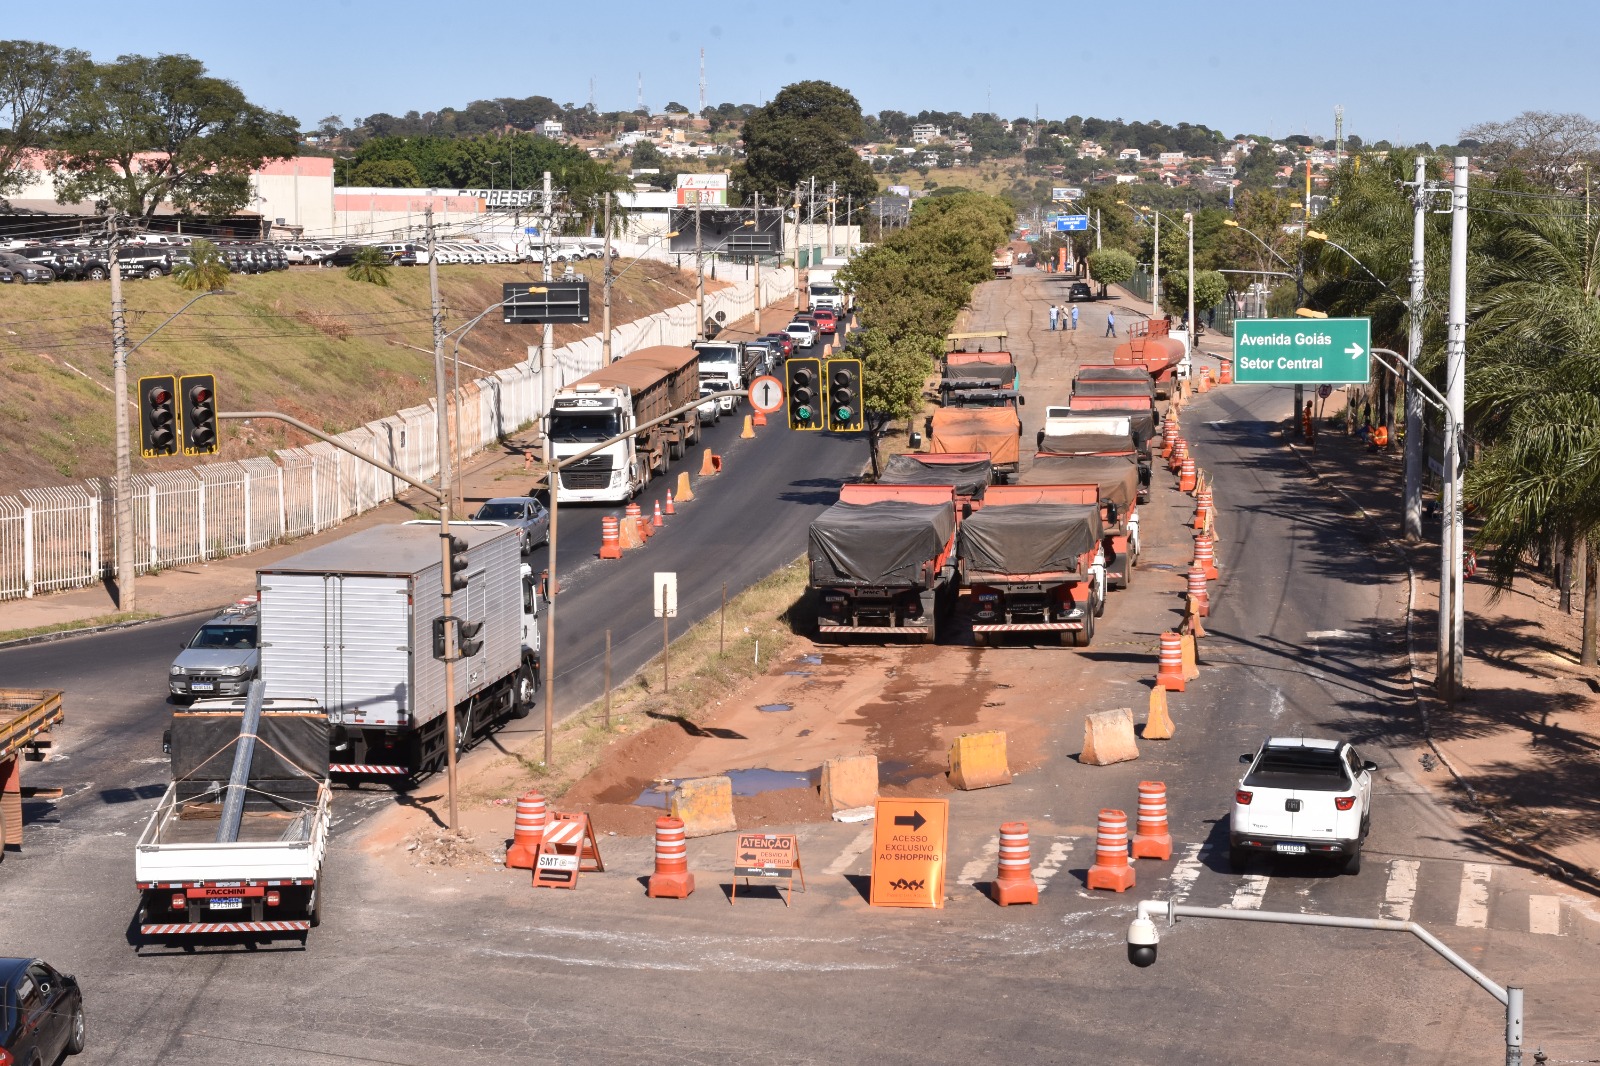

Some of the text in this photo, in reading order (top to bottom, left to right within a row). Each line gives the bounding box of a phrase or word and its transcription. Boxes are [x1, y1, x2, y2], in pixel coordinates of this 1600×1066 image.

[1240, 332, 1332, 346] Avenida Goiás
[1240, 357, 1323, 369] Setor Central
[741, 837, 790, 850] ATENÇÃO
[885, 844, 934, 852] EXCLUSIVO
[539, 857, 558, 866] SMT
[894, 853, 939, 862] SHOPPING
